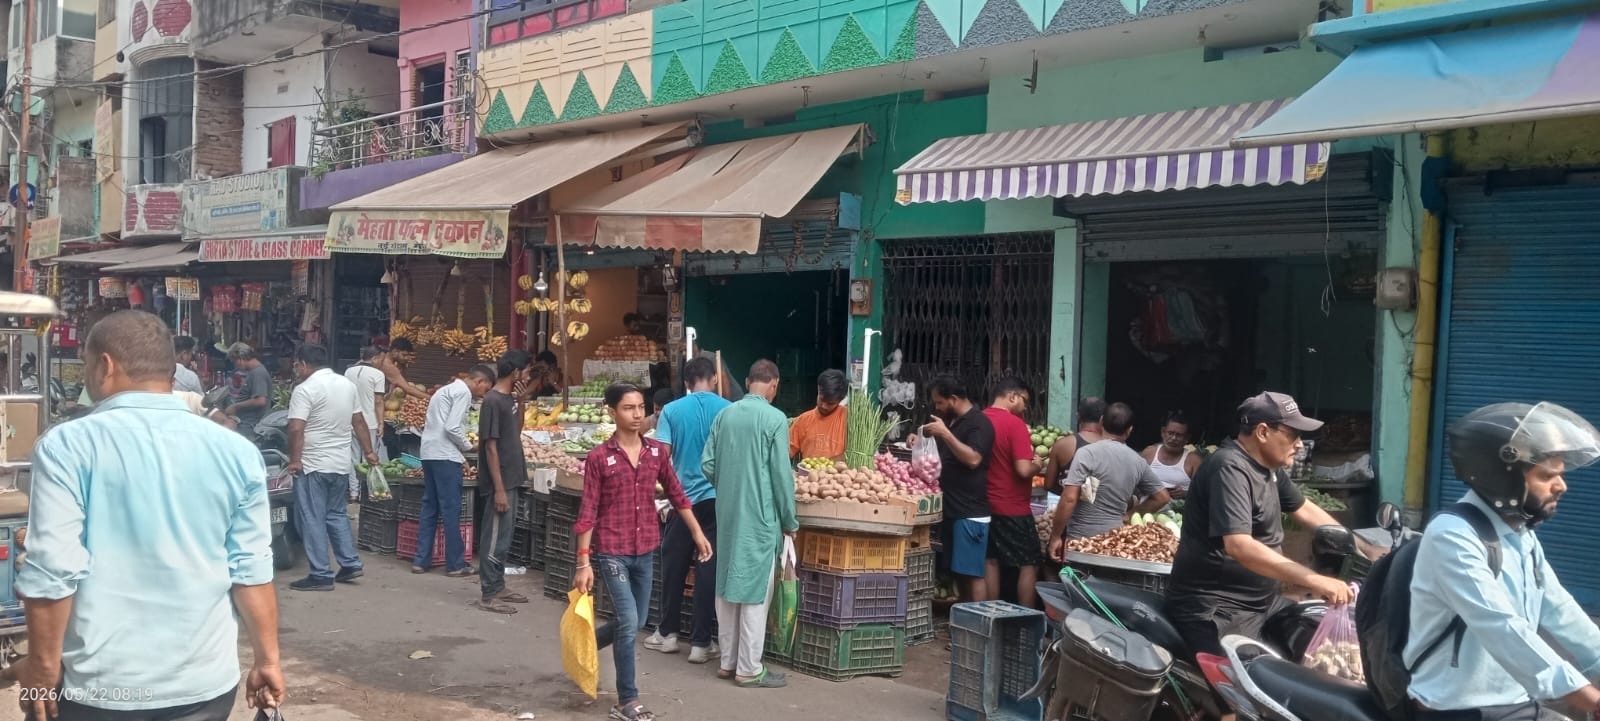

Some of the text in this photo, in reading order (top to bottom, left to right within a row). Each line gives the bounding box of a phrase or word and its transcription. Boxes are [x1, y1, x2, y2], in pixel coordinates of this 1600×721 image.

[227, 172, 263, 194] STUDIO
[356, 213, 397, 241] मेहता
[430, 218, 486, 249] दुकान
[204, 240, 228, 260] GUPTA
[228, 239, 253, 259] STORE
[254, 242, 260, 258] &
[261, 240, 288, 259] GLASS
